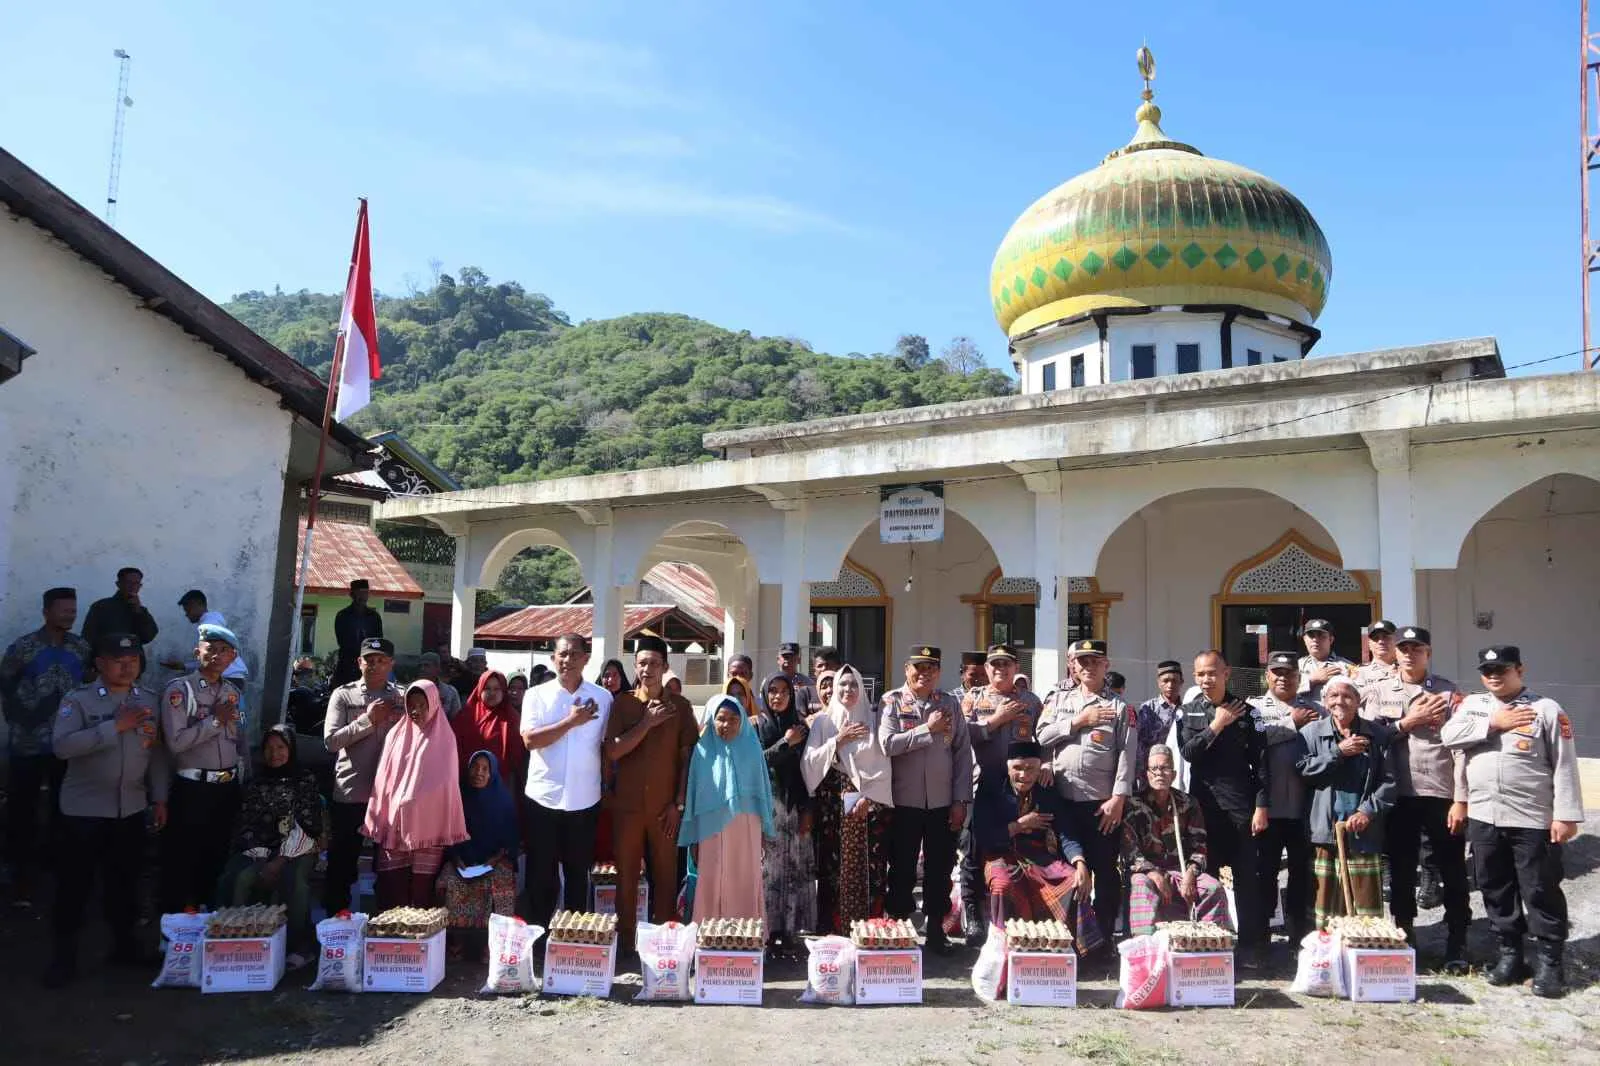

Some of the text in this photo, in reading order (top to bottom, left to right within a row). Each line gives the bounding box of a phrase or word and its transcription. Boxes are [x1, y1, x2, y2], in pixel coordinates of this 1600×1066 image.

[174, 942, 193, 953] 88
[326, 947, 345, 959] 88
[657, 959, 676, 970] 88
[818, 962, 838, 974] 88
